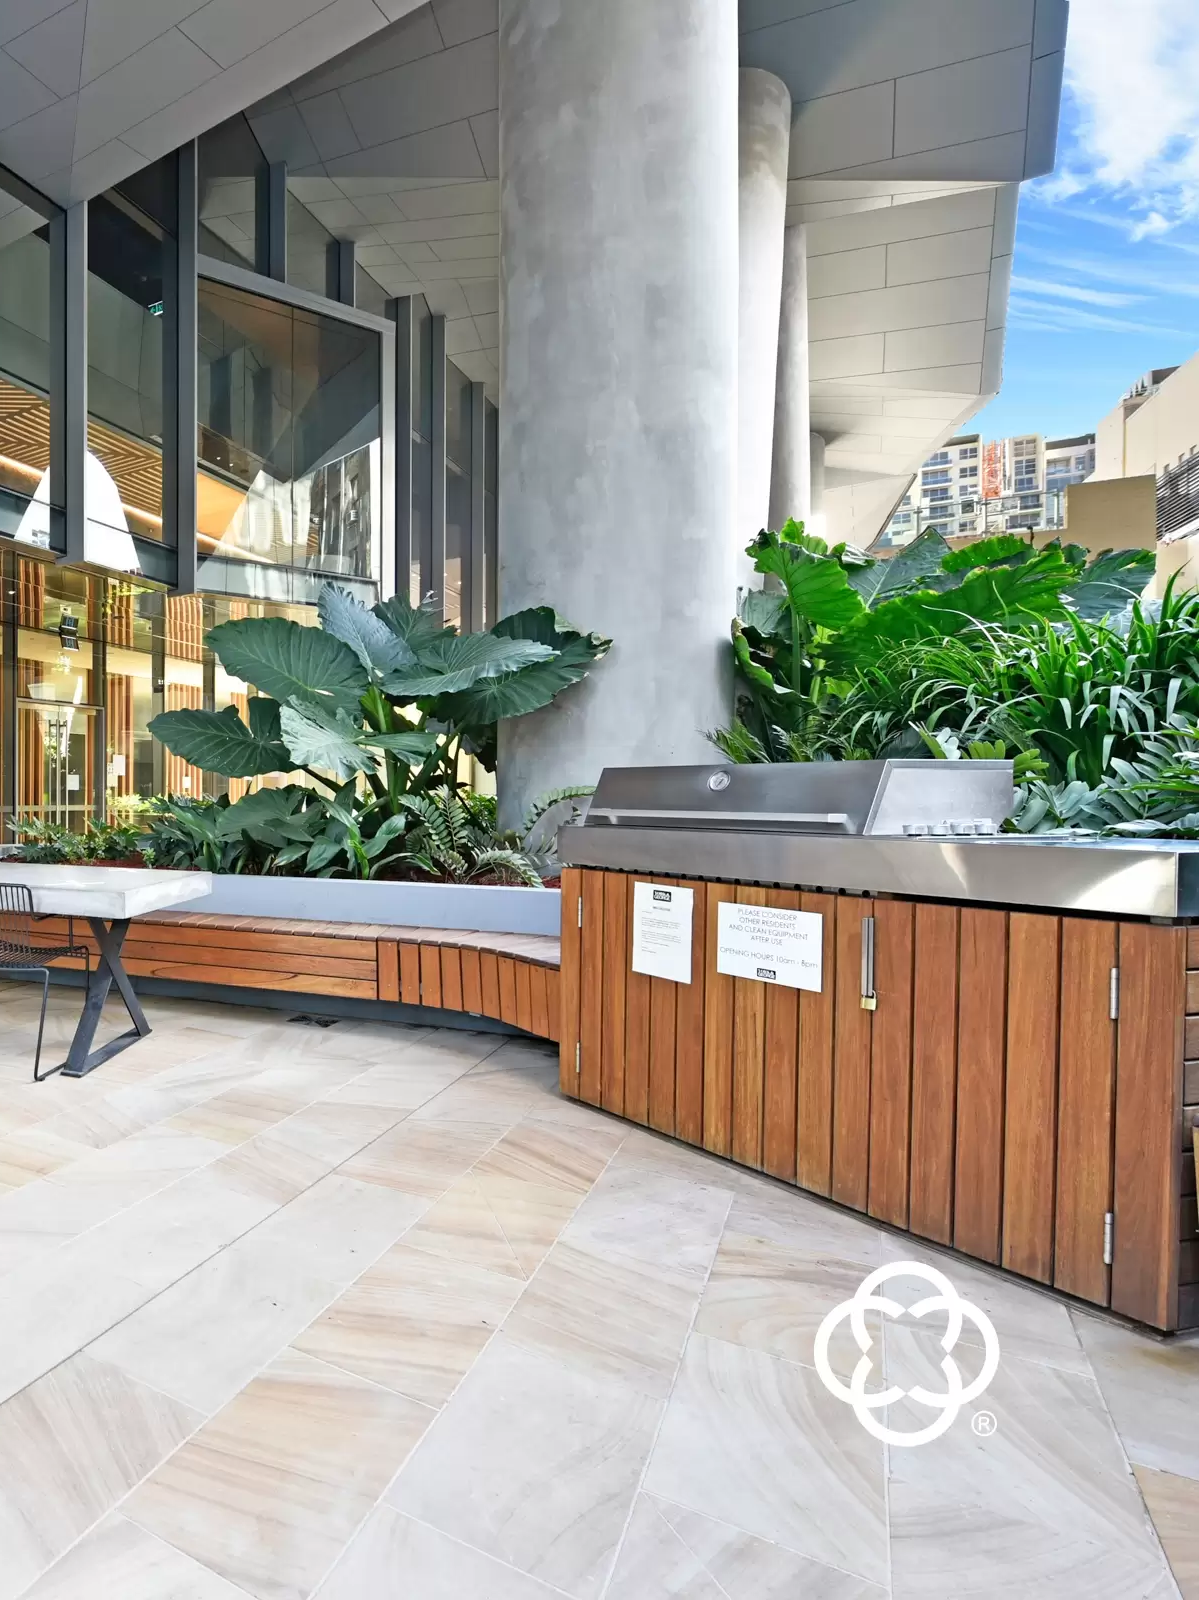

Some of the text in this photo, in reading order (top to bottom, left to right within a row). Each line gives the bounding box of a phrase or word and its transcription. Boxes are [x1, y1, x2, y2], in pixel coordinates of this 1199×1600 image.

[738, 908, 797, 921] PLEASE CONSIDER
[739, 917, 796, 930] OTHER RESIDENTS
[745, 926, 767, 934] CLEAN
[768, 929, 808, 940] EQUIPMENT
[771, 938, 783, 946] USE
[719, 946, 750, 957] OPENING
[751, 952, 774, 962] HOURS
[776, 956, 795, 965] 10am
[801, 959, 818, 969] 8pm
